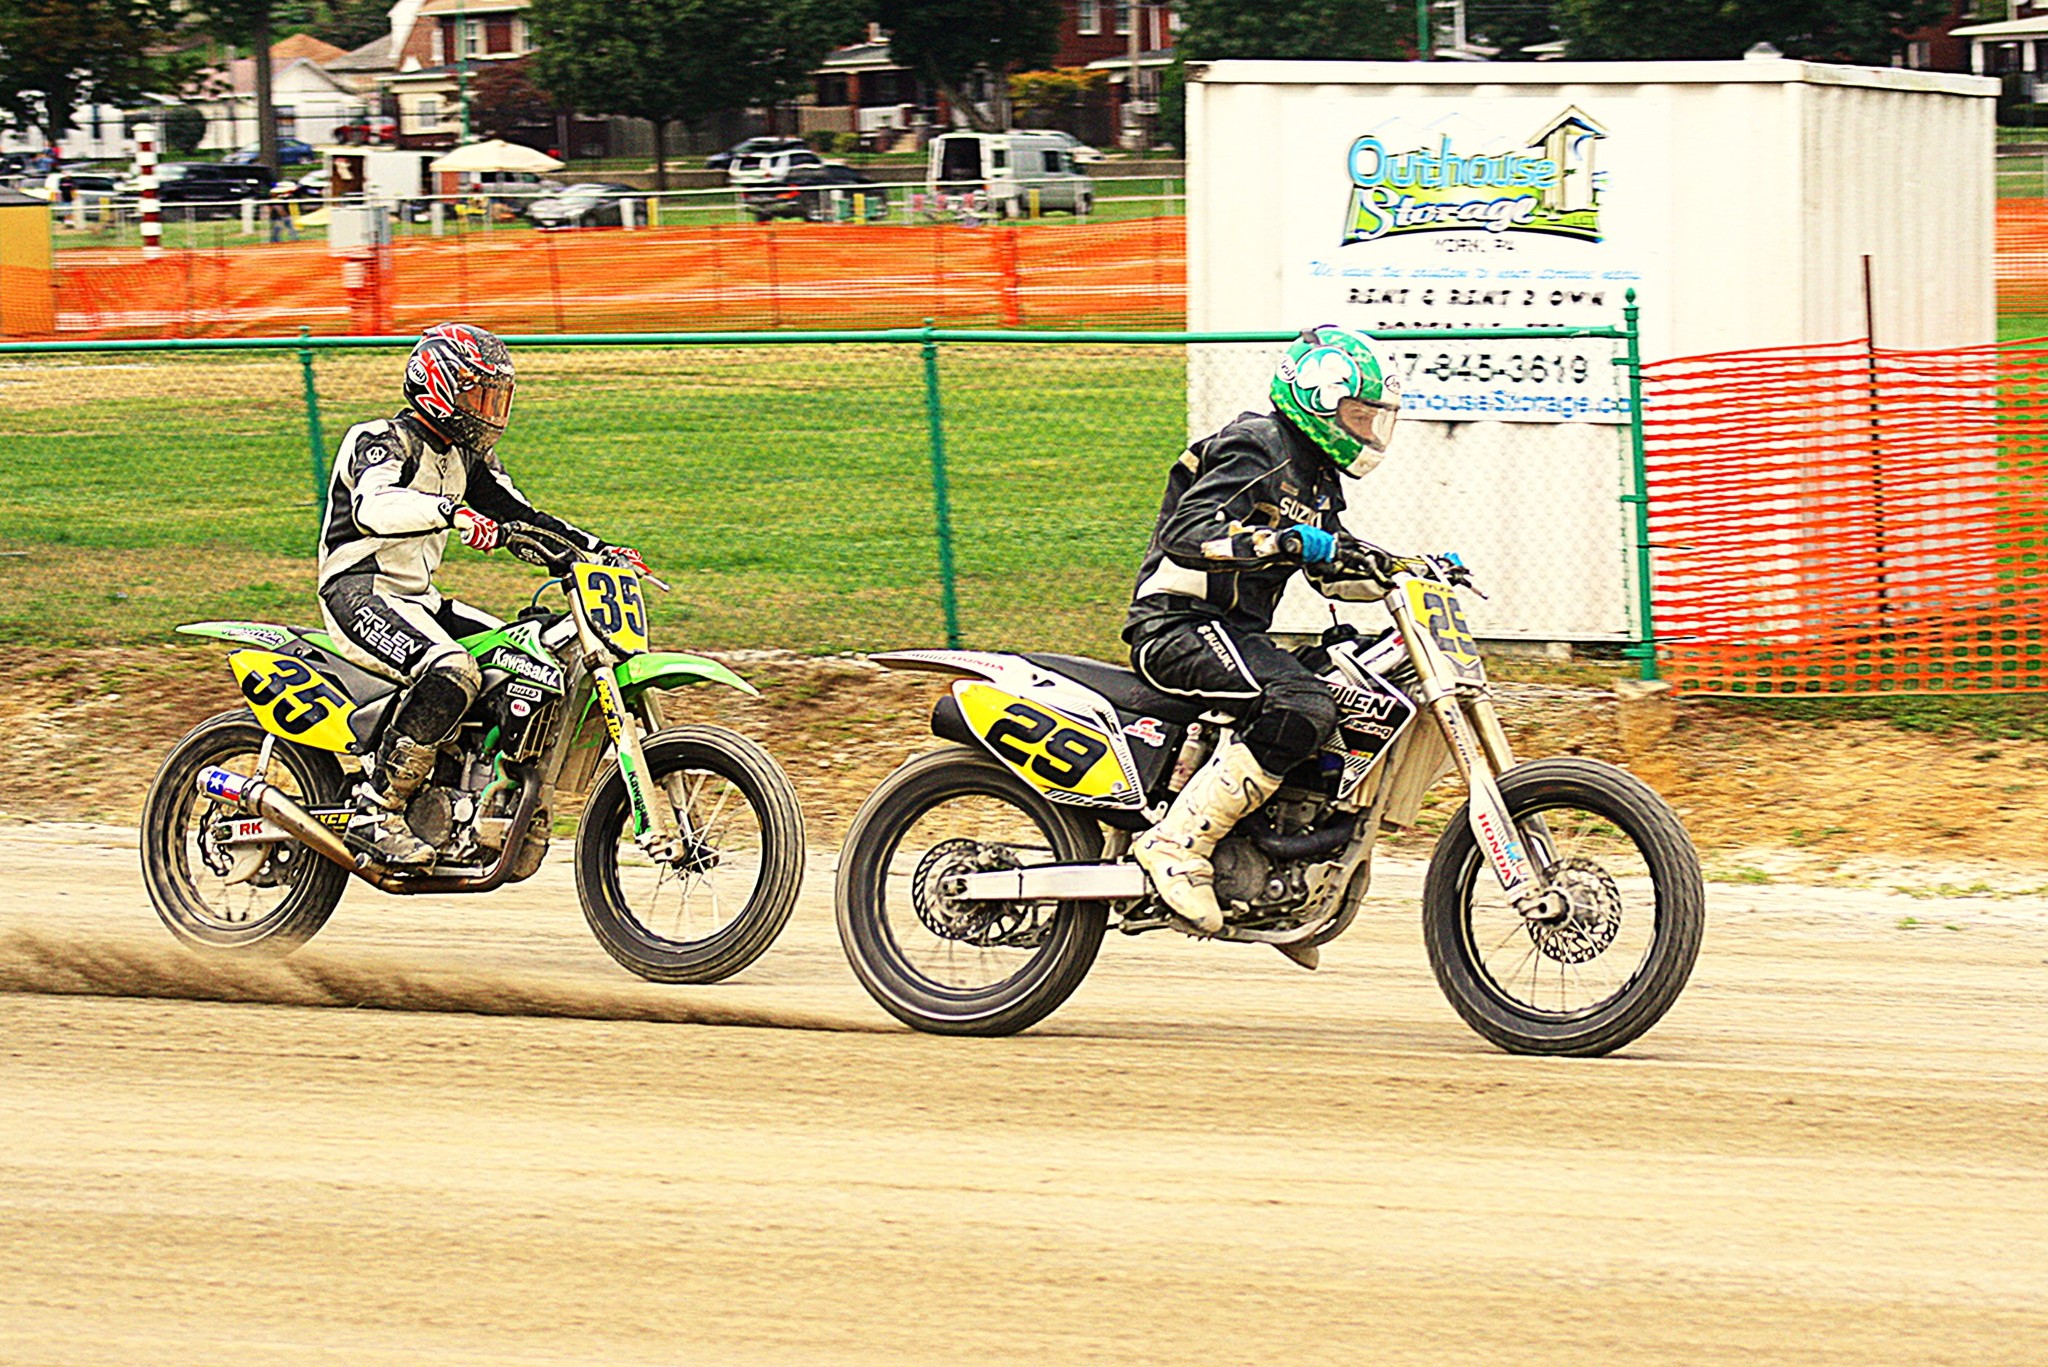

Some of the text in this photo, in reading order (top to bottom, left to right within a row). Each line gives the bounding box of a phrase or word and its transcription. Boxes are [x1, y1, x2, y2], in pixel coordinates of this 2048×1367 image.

[1347, 133, 1559, 189] Outhouse
[1356, 186, 1539, 239] Storage
[587, 571, 645, 636] 35
[352, 620, 407, 665] NESS
[354, 606, 423, 655] ARLEN
[1203, 632, 1237, 672] SUZUKI
[491, 647, 560, 688] Kawasaki
[241, 659, 346, 735] 35
[984, 703, 1108, 789] 29
[239, 821, 263, 836] RK
[1478, 813, 1512, 881] HONDA
